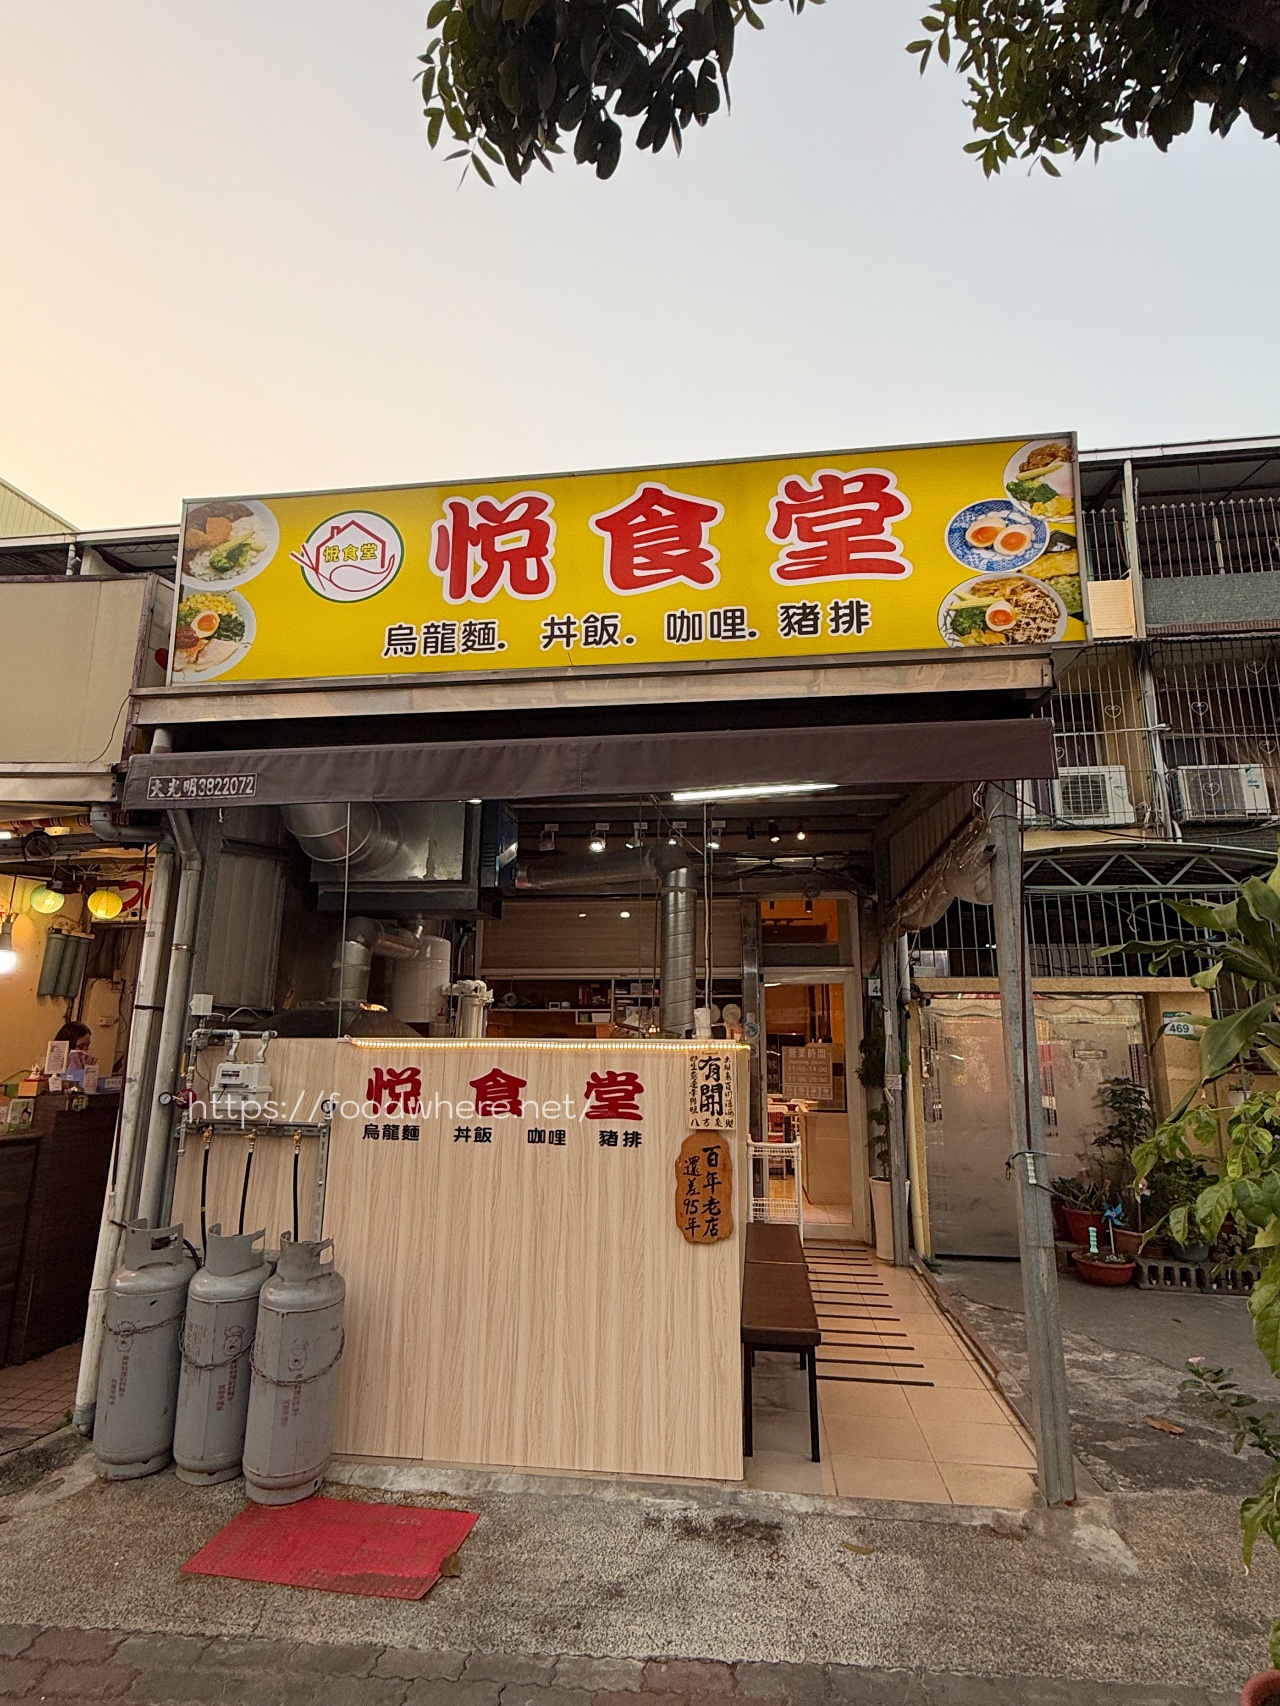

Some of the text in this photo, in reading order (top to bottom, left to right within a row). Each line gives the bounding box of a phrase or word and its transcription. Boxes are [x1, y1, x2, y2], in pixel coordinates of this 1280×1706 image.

[779, 600, 871, 637] 豬排
[1169, 1024, 1189, 1033] 469
[698, 1055, 723, 1117] 有開
[362, 1123, 643, 1148] 烏龍麵 丼飯 咖哩 豬排
[682, 1155, 702, 1238] 還差95年
[701, 1145, 722, 1237] 百年老店
